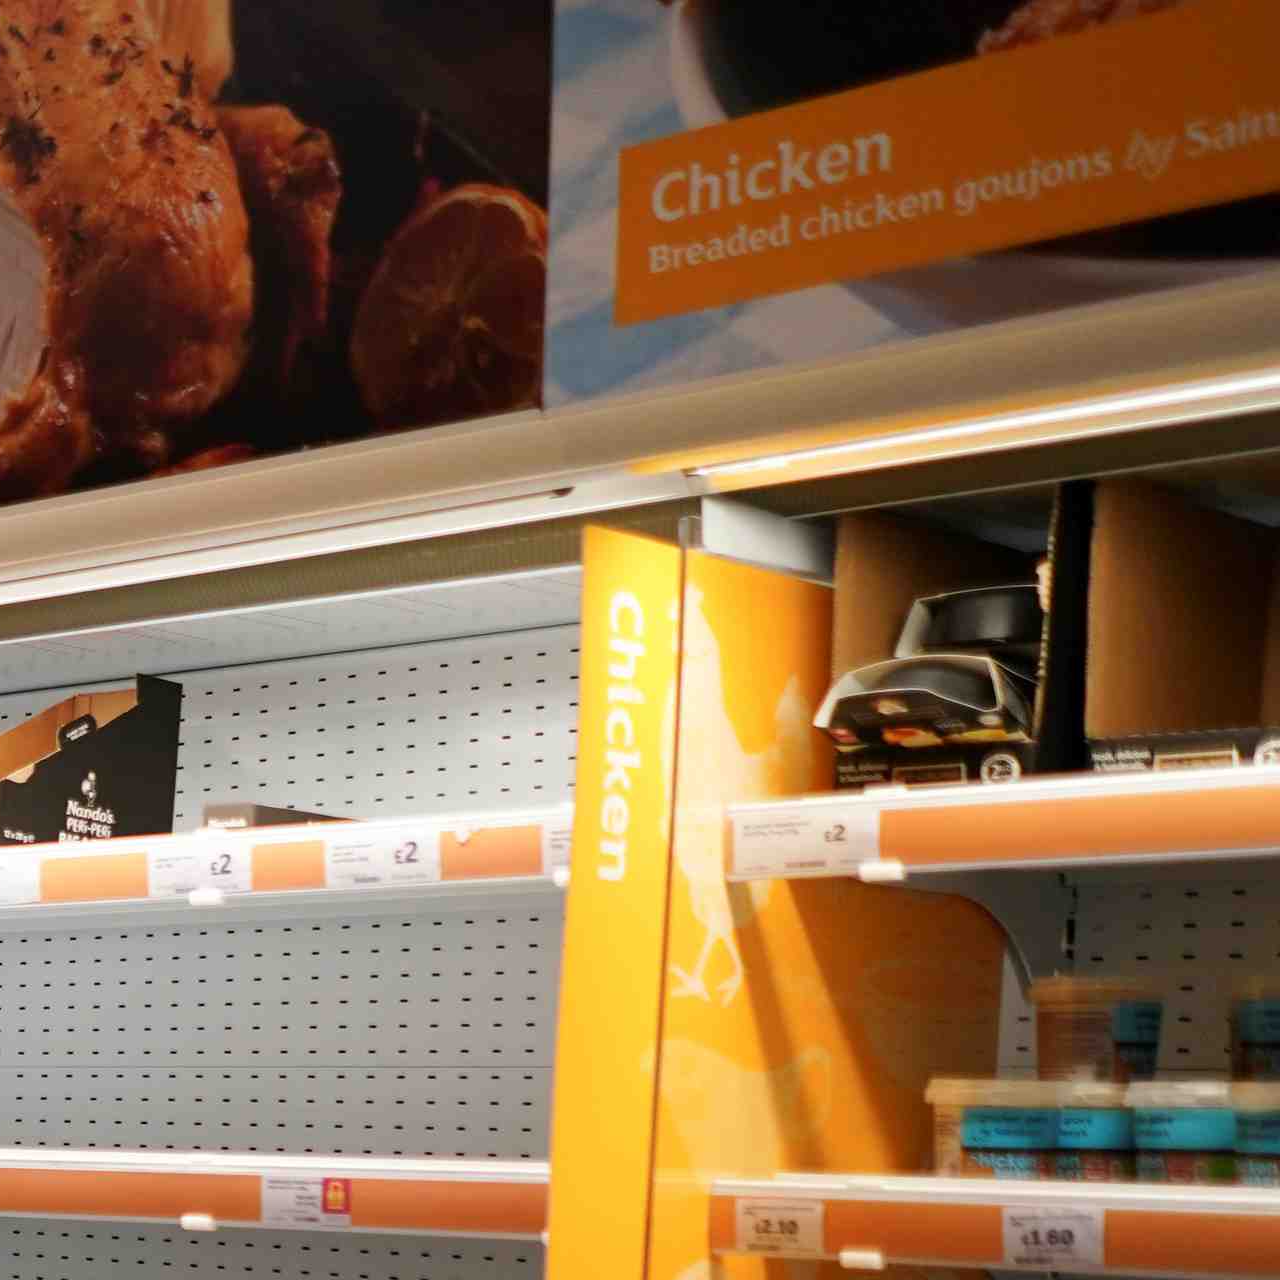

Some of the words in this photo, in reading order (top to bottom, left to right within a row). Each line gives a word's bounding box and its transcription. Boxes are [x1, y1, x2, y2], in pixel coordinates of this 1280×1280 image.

[651, 132, 893, 223] Chicken
[649, 213, 792, 273] Breaded
[799, 187, 945, 240] chicken
[953, 147, 1112, 217] goujons
[597, 591, 646, 881] Chicken
[66, 799, 115, 824] Nando's
[211, 854, 231, 876] £2
[394, 841, 419, 864] £2
